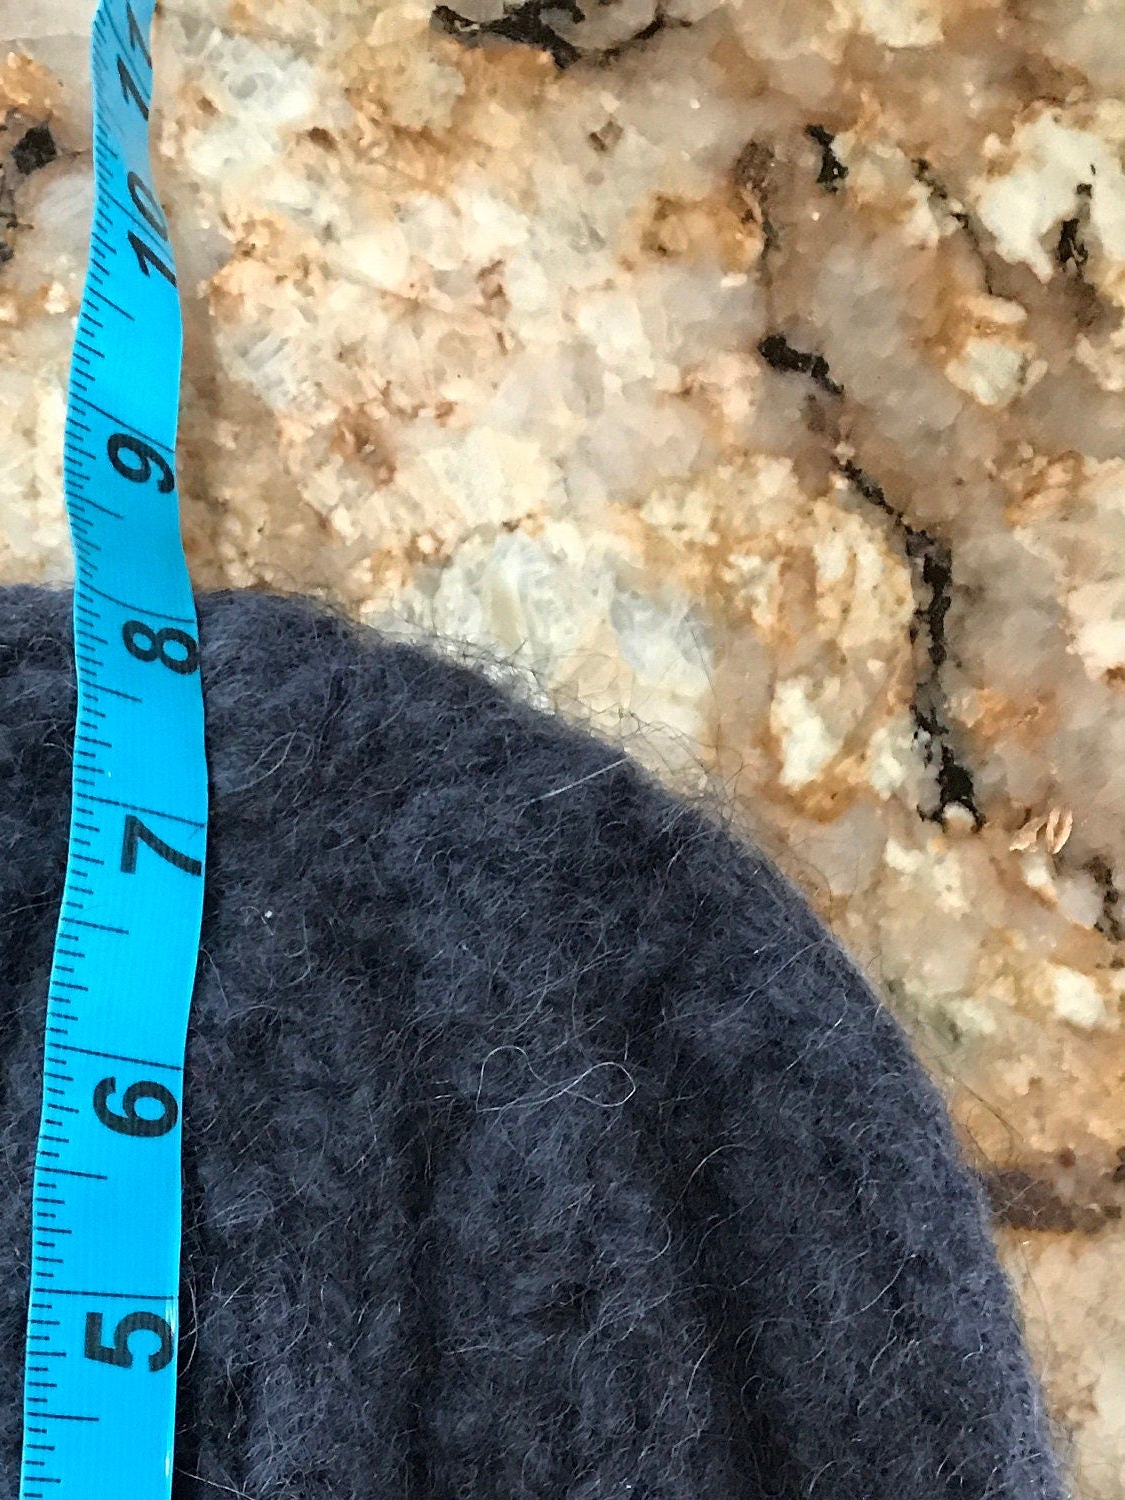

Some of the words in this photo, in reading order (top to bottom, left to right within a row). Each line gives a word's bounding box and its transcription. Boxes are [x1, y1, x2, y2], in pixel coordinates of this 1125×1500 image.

[127, 171, 178, 287] 10
[106, 433, 175, 494] 9
[122, 620, 199, 675] 8
[120, 815, 202, 877] 7
[93, 1077, 179, 1138] 6
[84, 1311, 174, 1373] 5
